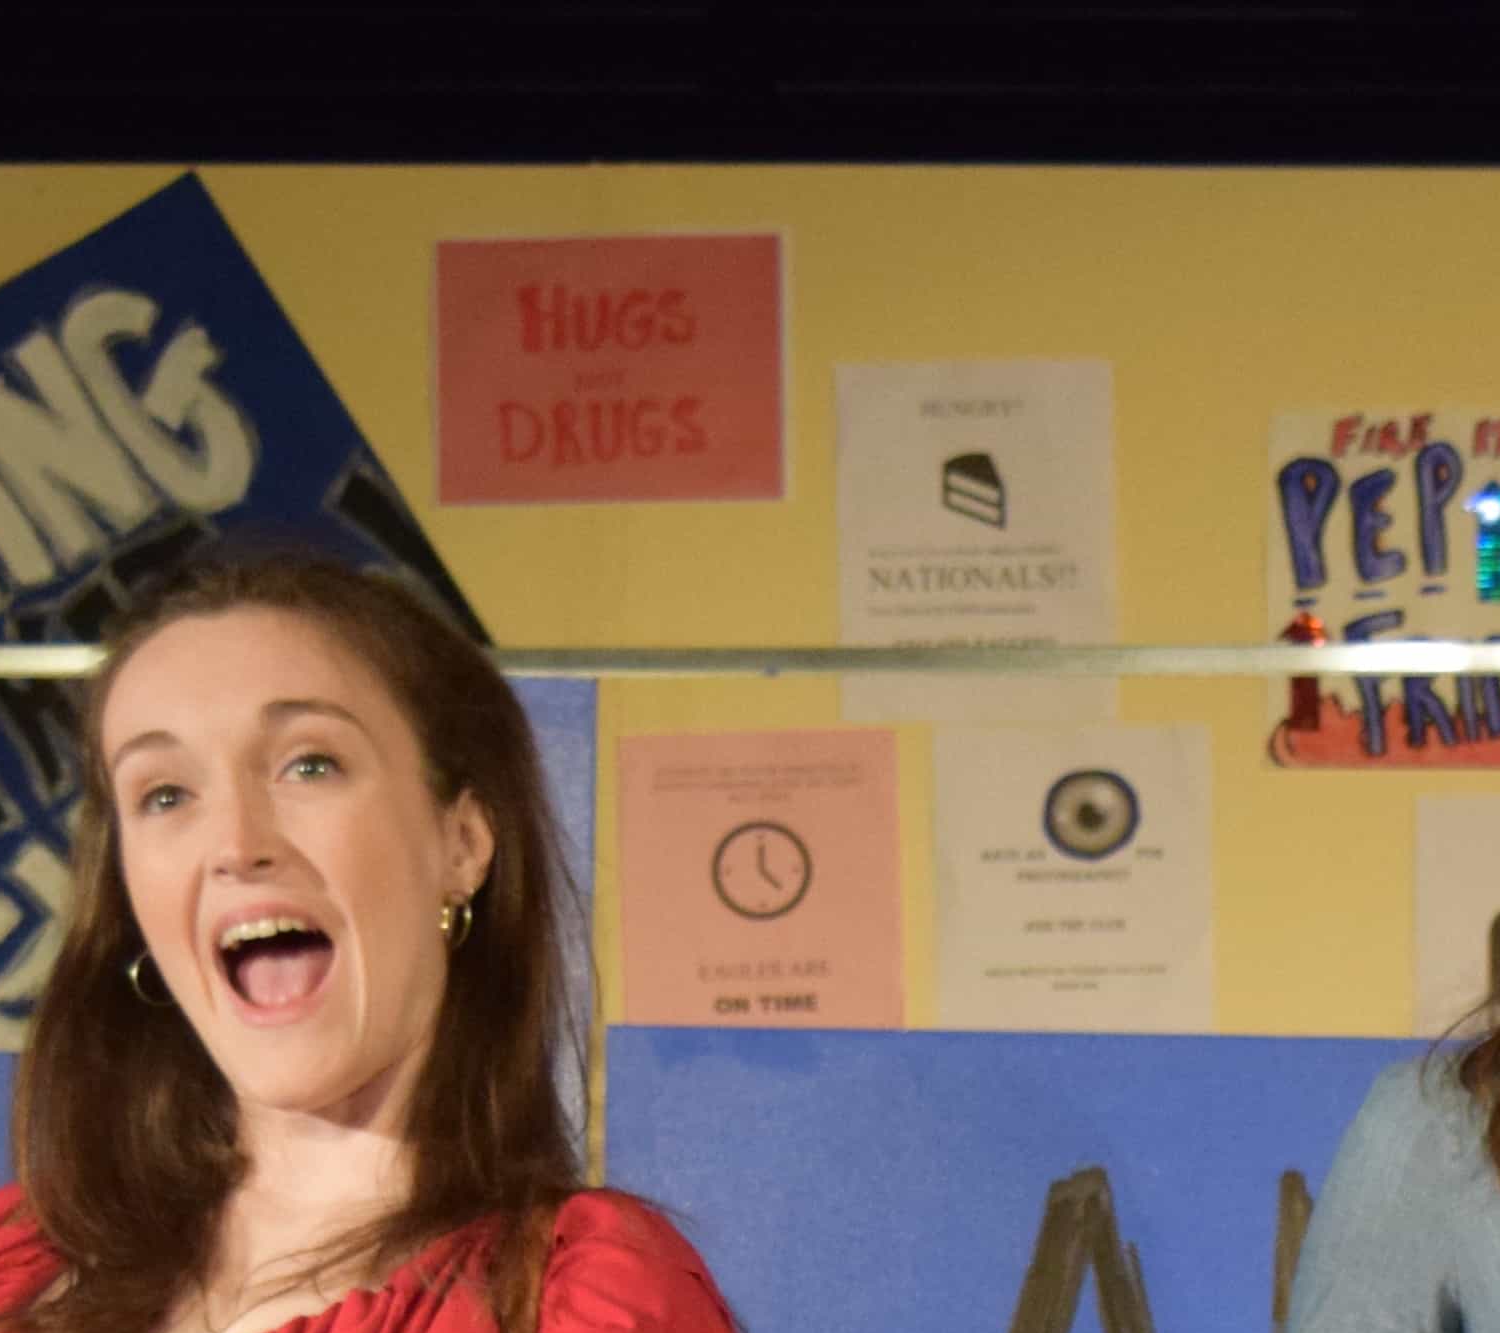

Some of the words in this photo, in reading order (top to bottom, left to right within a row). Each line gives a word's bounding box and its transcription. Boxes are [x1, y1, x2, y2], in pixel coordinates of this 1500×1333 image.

[516, 283, 698, 352] HUGS
[498, 395, 709, 466] DRUGS
[1277, 441, 1467, 592] PEP
